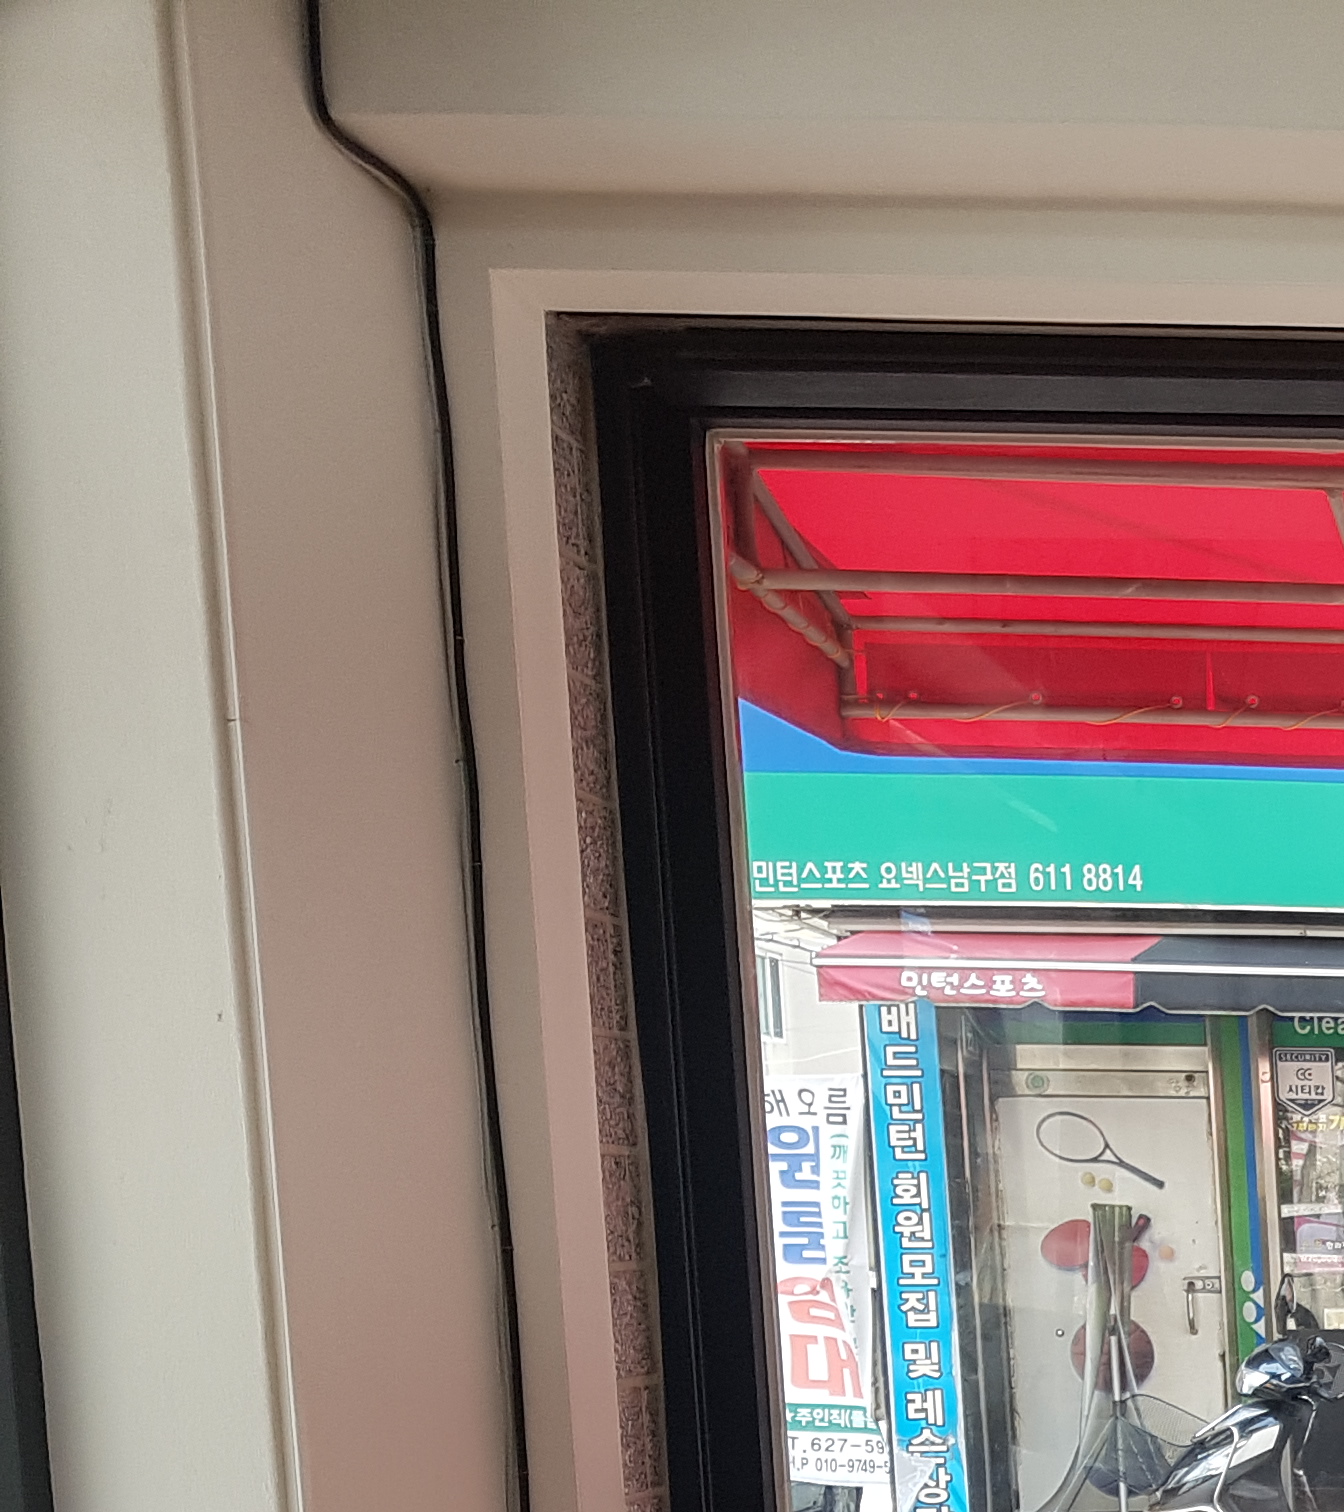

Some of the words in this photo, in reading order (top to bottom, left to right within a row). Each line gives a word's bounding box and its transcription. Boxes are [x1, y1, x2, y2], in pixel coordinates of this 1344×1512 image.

[752, 860, 870, 893] 민턴스포츠
[878, 861, 1017, 893] 요넥스남구점
[1028, 862, 1072, 892] 611
[1082, 863, 1143, 892] 8814
[900, 970, 1046, 998] 민턴스포츠
[880, 1001, 928, 1160] 배드민턴
[890, 1169, 940, 1328] 회원모집
[902, 1340, 942, 1379] 및
